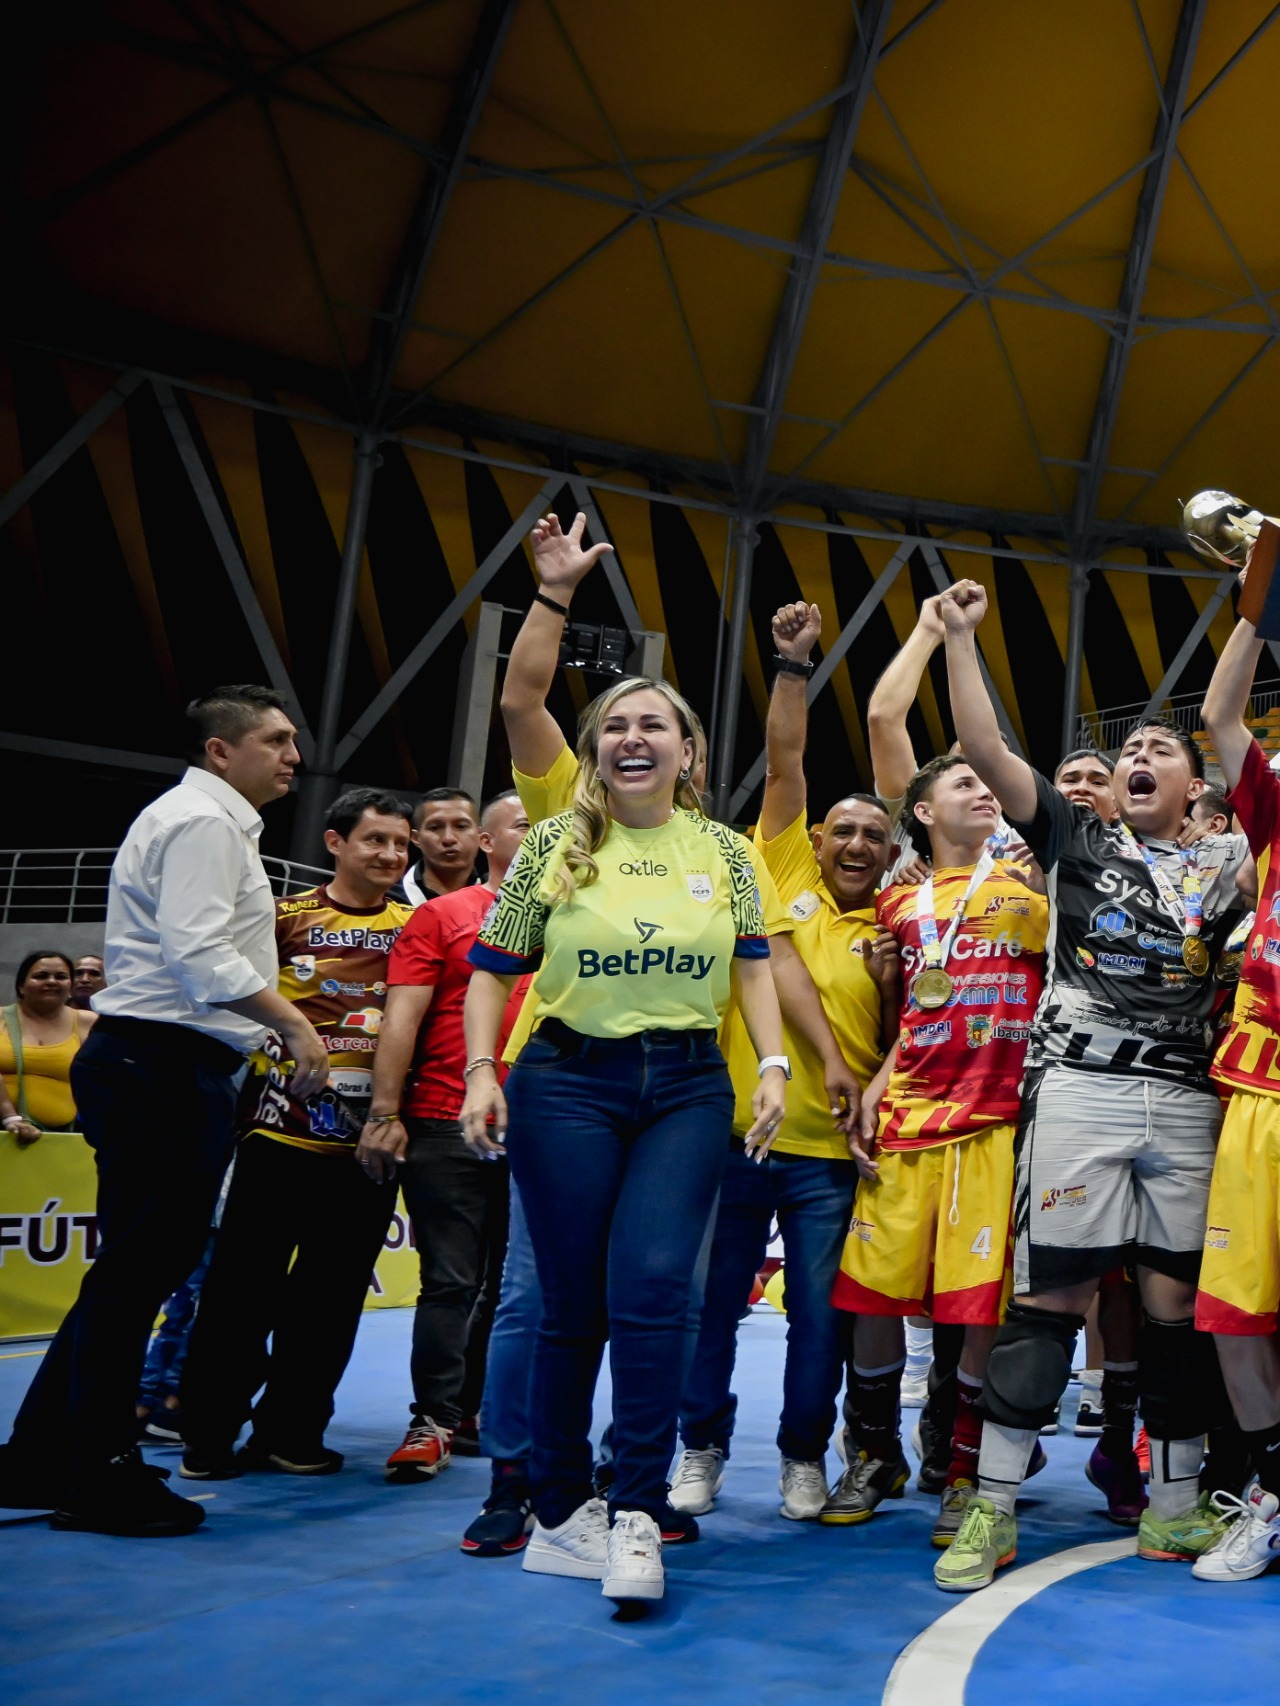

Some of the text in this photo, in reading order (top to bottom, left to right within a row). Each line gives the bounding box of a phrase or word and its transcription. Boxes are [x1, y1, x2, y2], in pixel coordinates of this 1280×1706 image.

[308, 926, 396, 954] BetPlay
[901, 932, 1023, 973] SyCafé
[1098, 952, 1146, 970] IMDRI
[578, 946, 716, 980] BetPlay
[950, 972, 1027, 985] NVERSIONES
[913, 1021, 951, 1037] IMDRI
[993, 1026, 1031, 1042] Ibagu
[337, 1083, 362, 1092] Obras
[970, 1226, 992, 1260] 4
